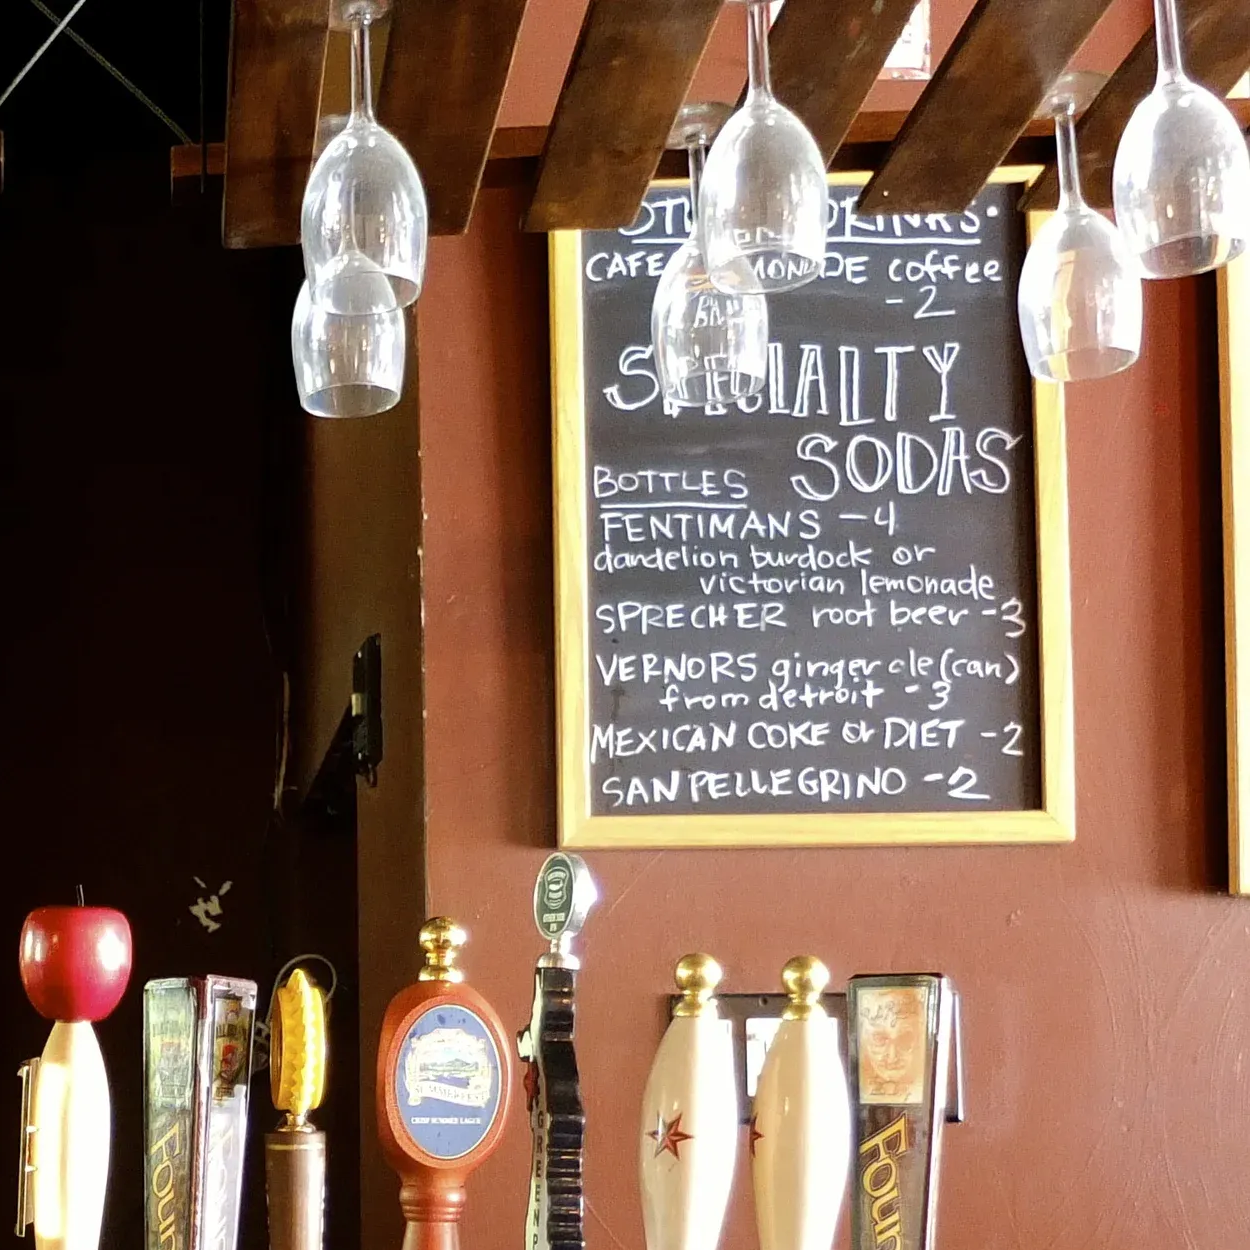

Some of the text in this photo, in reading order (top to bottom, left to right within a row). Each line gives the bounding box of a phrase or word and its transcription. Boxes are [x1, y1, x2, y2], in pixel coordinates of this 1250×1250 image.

[585, 250, 665, 282] CAFE
[888, 249, 1003, 283] coffee
[593, 465, 749, 500] BOTTLES
[790, 427, 1024, 501] SODAS
[600, 509, 821, 542] FENTIMANS
[593, 539, 936, 574] dandelion burdock or
[699, 563, 996, 600] victorian lemonade
[595, 601, 788, 635] SPRECHER
[812, 598, 877, 628] root
[890, 599, 969, 626] beer
[595, 652, 758, 686] VERNORS
[771, 652, 882, 692] ginger
[939, 647, 1020, 685] (can)
[658, 684, 750, 713] from
[758, 678, 885, 712] detroit
[590, 719, 737, 765] MEXICAN
[747, 719, 830, 751] COKE
[883, 717, 966, 750] DIET
[602, 769, 681, 808] SAN
[688, 766, 907, 803] PELLEGRINO
